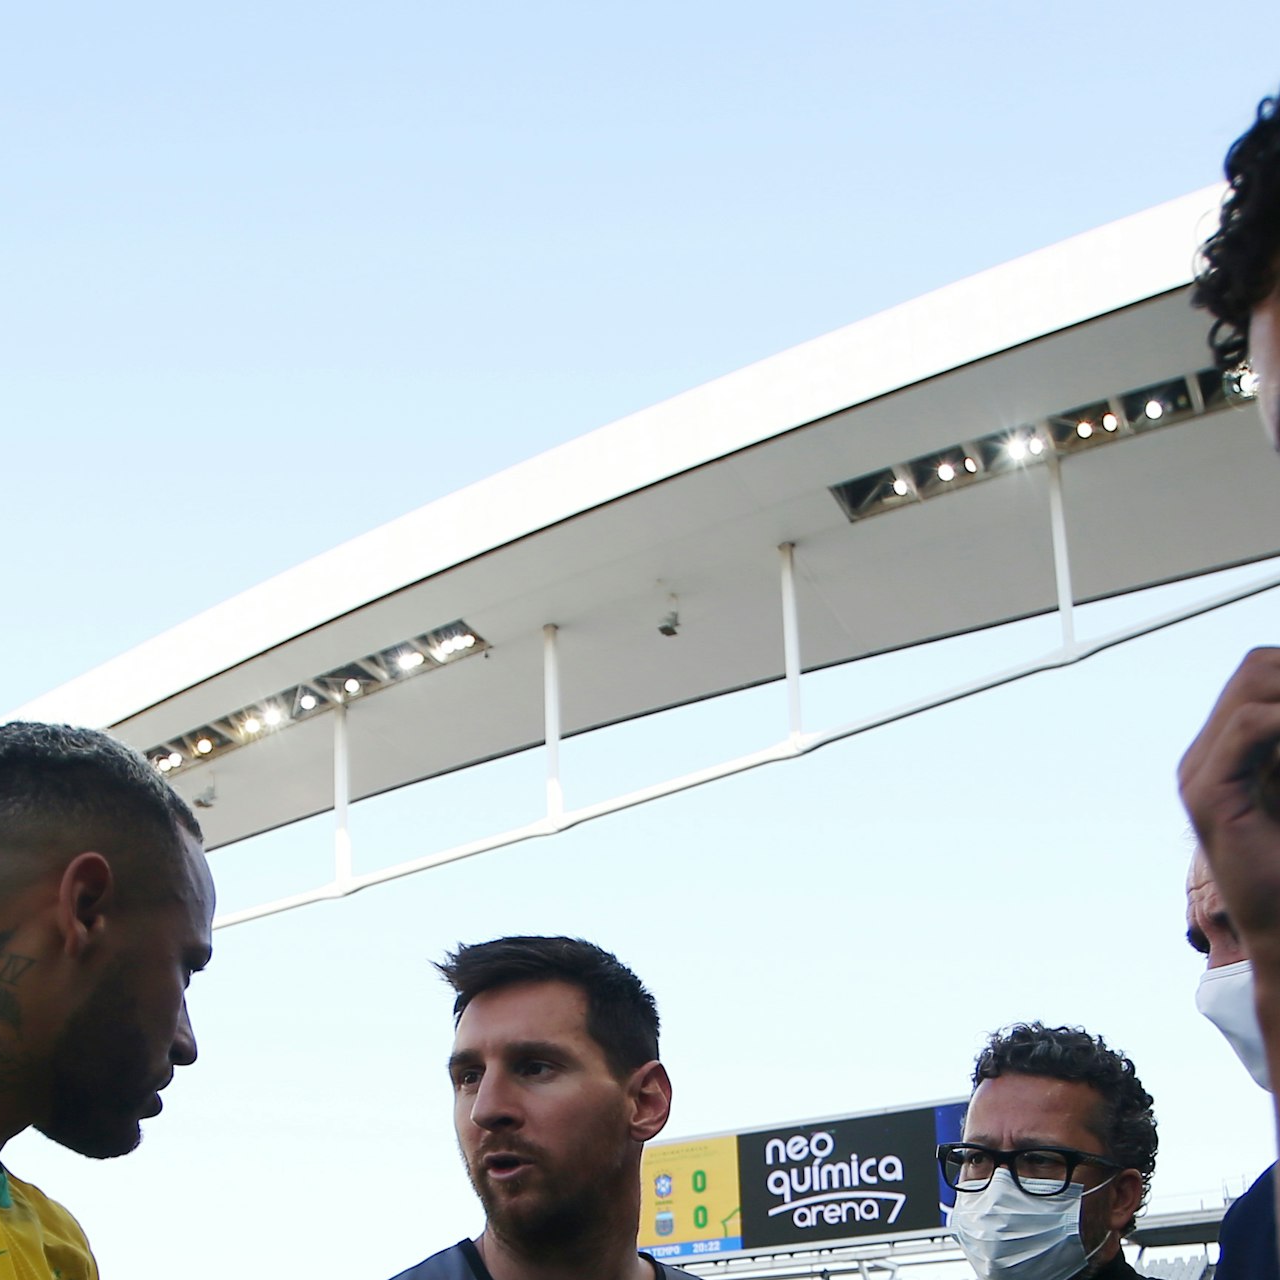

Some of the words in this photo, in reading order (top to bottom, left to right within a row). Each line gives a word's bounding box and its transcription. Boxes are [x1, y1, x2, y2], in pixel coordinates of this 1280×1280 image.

[765, 1131, 835, 1165] neo
[692, 1169, 707, 1193] 0
[767, 1153, 903, 1204] química
[693, 1205, 708, 1229] 0
[793, 1199, 880, 1228] arena
